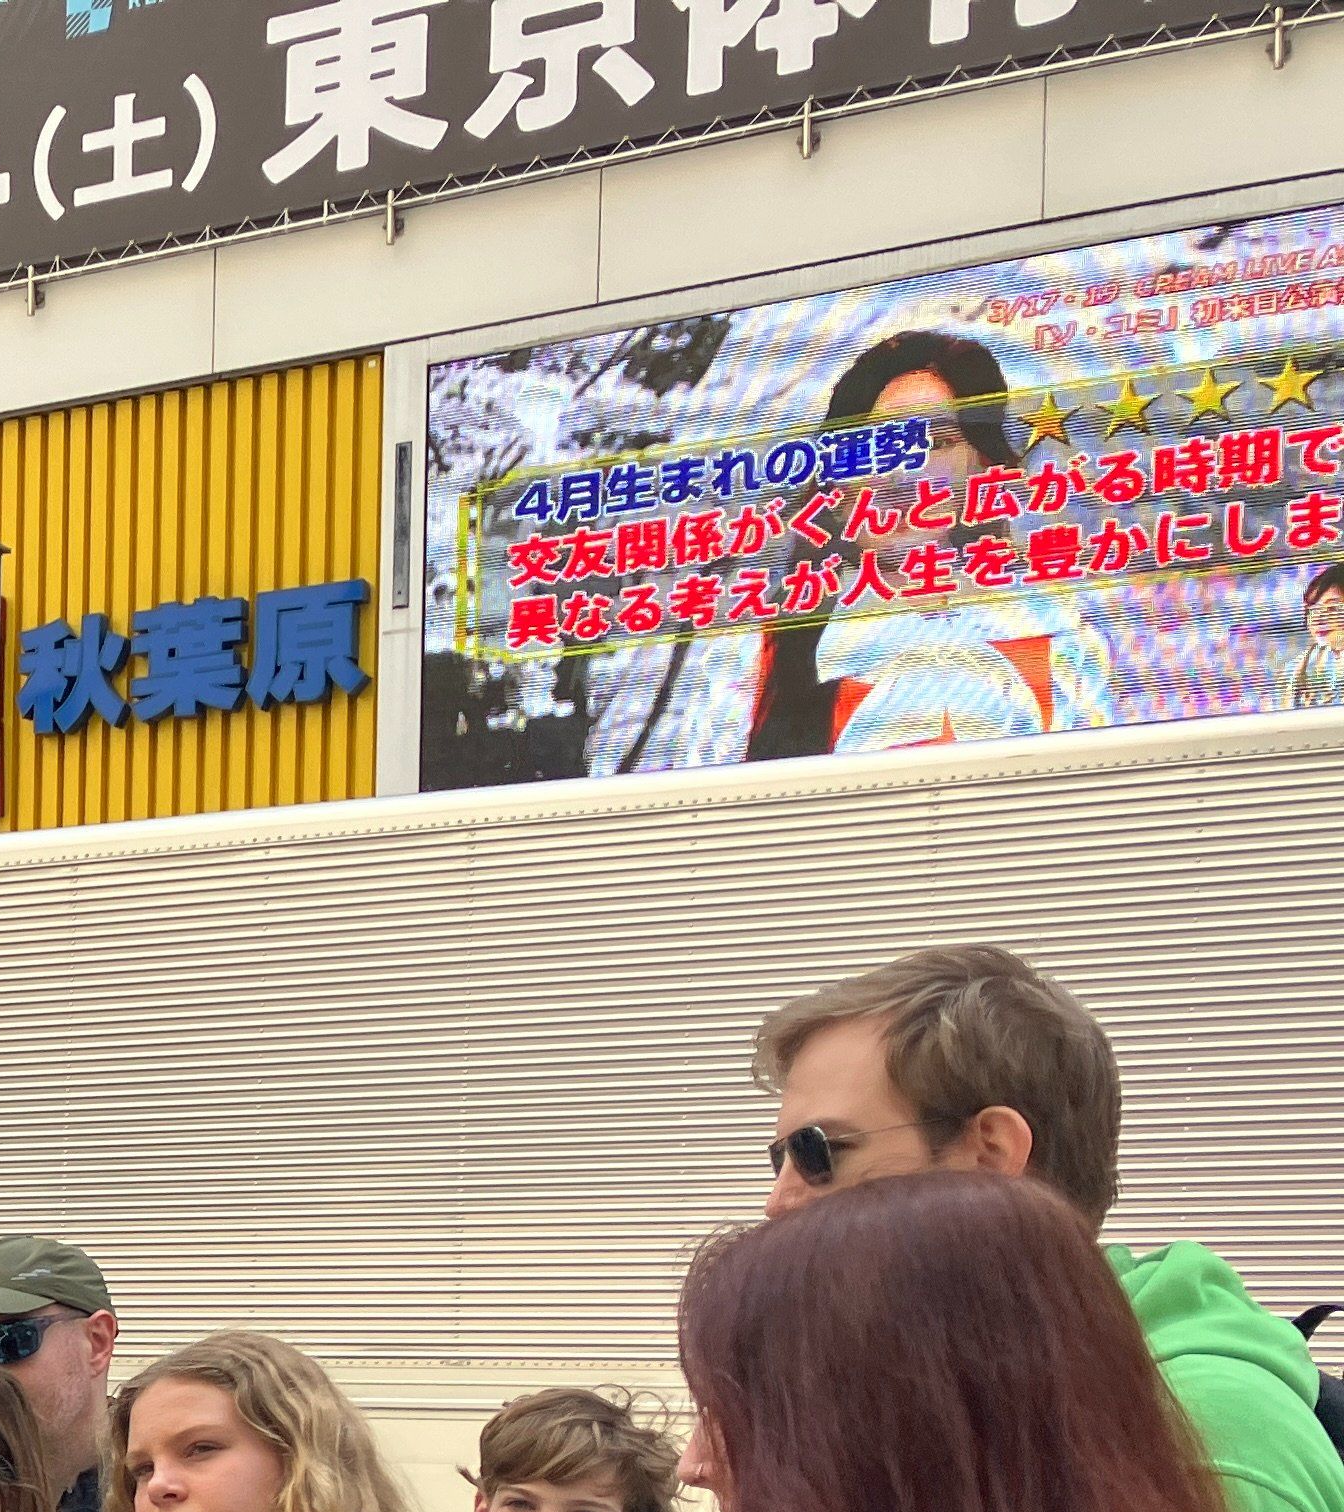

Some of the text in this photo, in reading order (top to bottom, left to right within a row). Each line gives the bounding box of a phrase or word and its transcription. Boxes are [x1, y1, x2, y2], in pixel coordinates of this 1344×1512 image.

[514, 417, 931, 523] 4月生まれの運勢
[17, 577, 372, 735] 秋葉原
